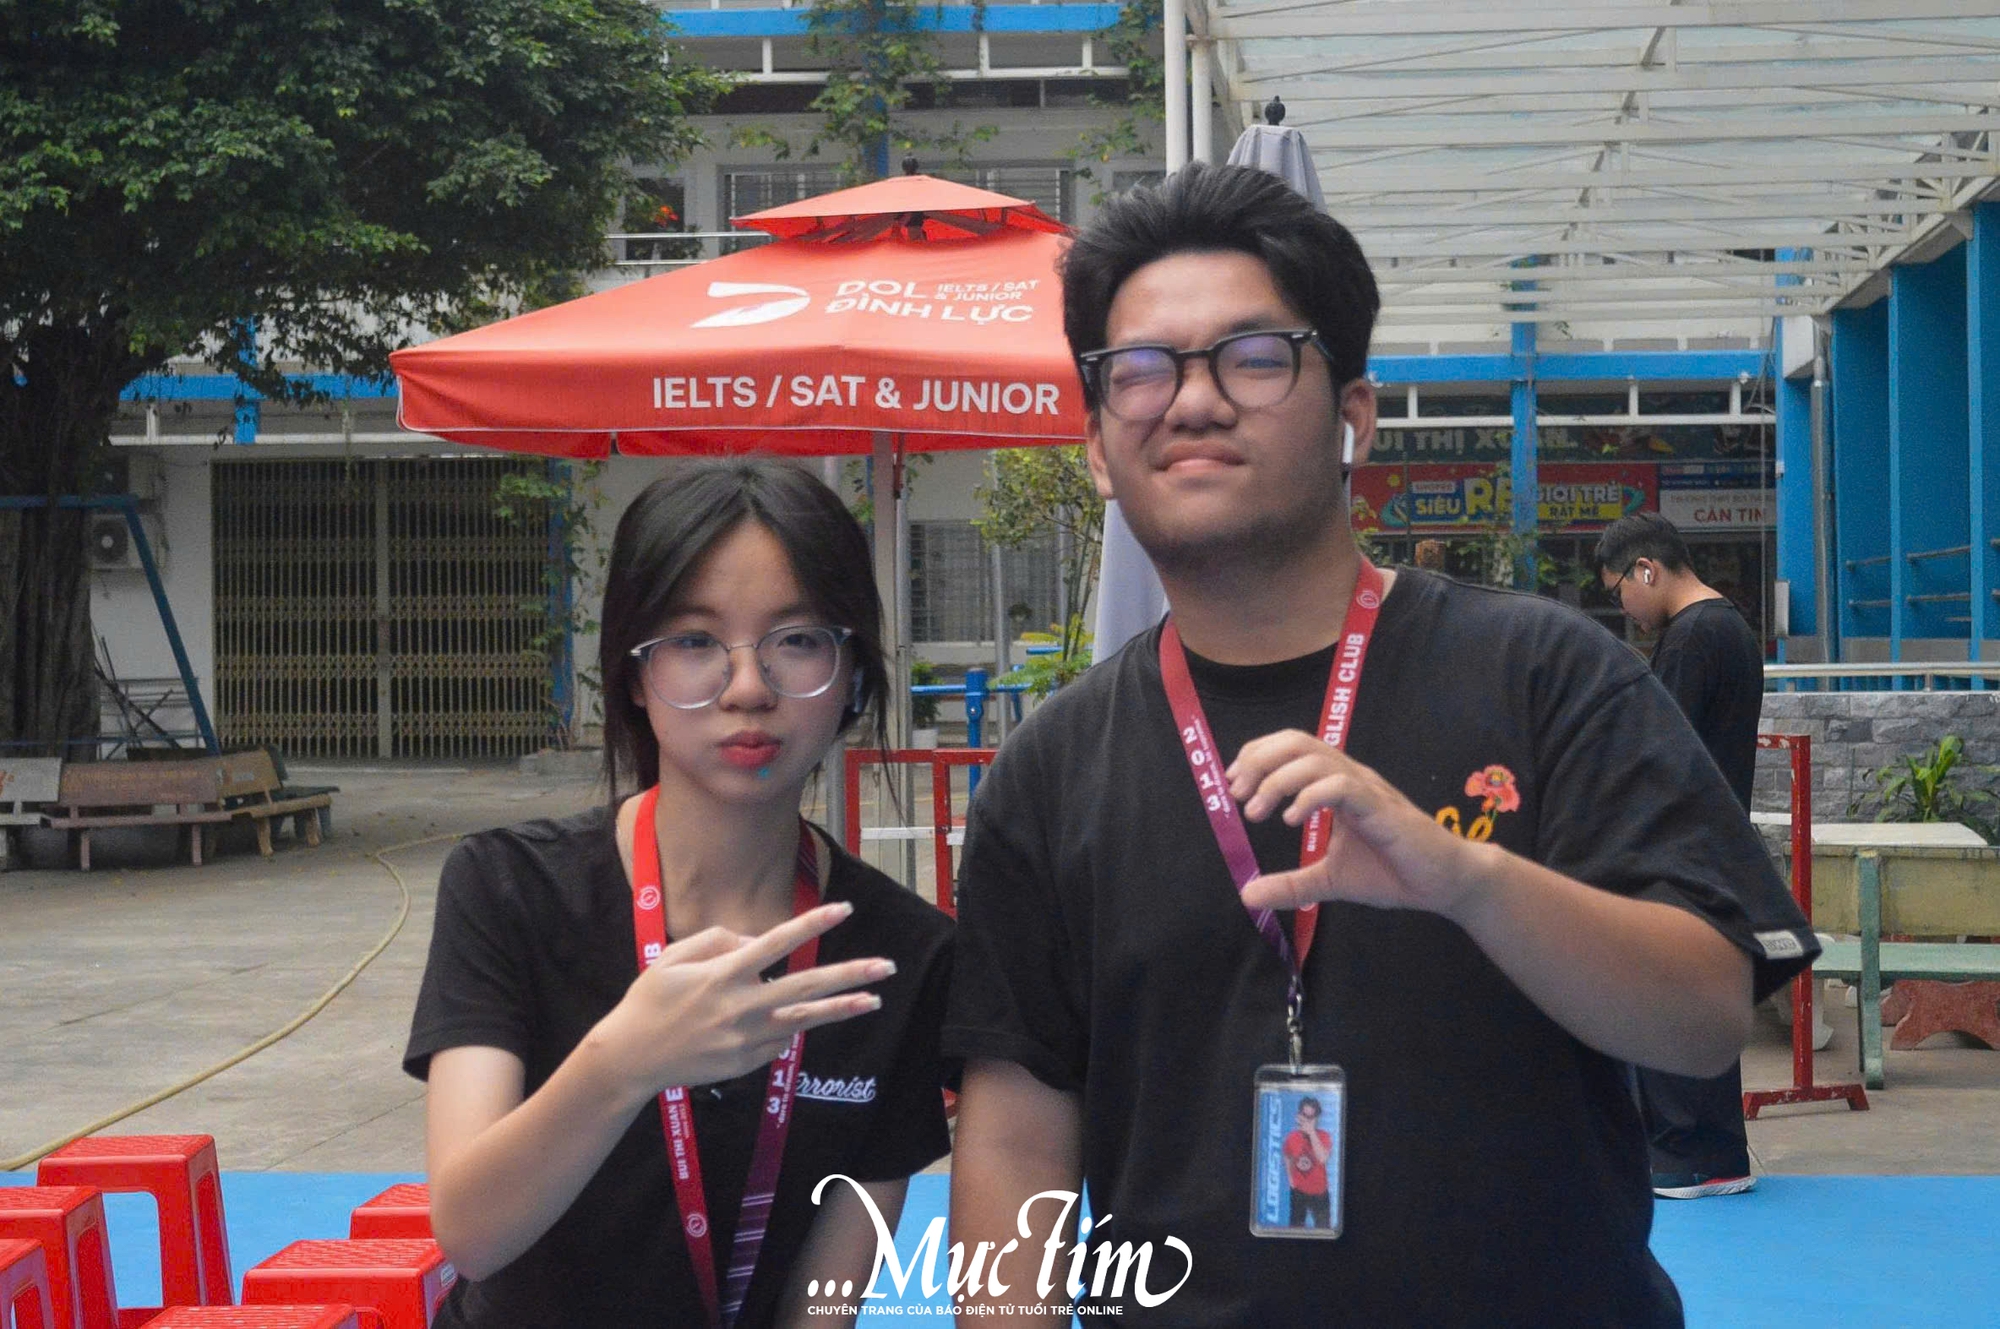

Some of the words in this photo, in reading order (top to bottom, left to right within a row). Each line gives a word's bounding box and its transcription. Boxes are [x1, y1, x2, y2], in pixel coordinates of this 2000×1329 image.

[836, 280, 927, 299] DOL
[937, 283, 989, 293] IELTS
[1000, 279, 1040, 291] SAT
[953, 291, 1023, 301] JUNIOR
[825, 293, 933, 318] ĐÌNH
[941, 303, 1034, 325] LỰC
[653, 376, 757, 408] IELTS
[766, 375, 782, 408] /
[790, 375, 865, 408] SAT
[874, 377, 901, 409] &
[912, 379, 1059, 415] JUNIOR
[1323, 686, 1352, 747] GLISH
[1338, 633, 1365, 683] CLUB
[668, 1104, 681, 1137] XUAN
[673, 1139, 685, 1158] THI
[1266, 1095, 1282, 1223] LOGISTICS
[677, 1159, 689, 1180] BUI
